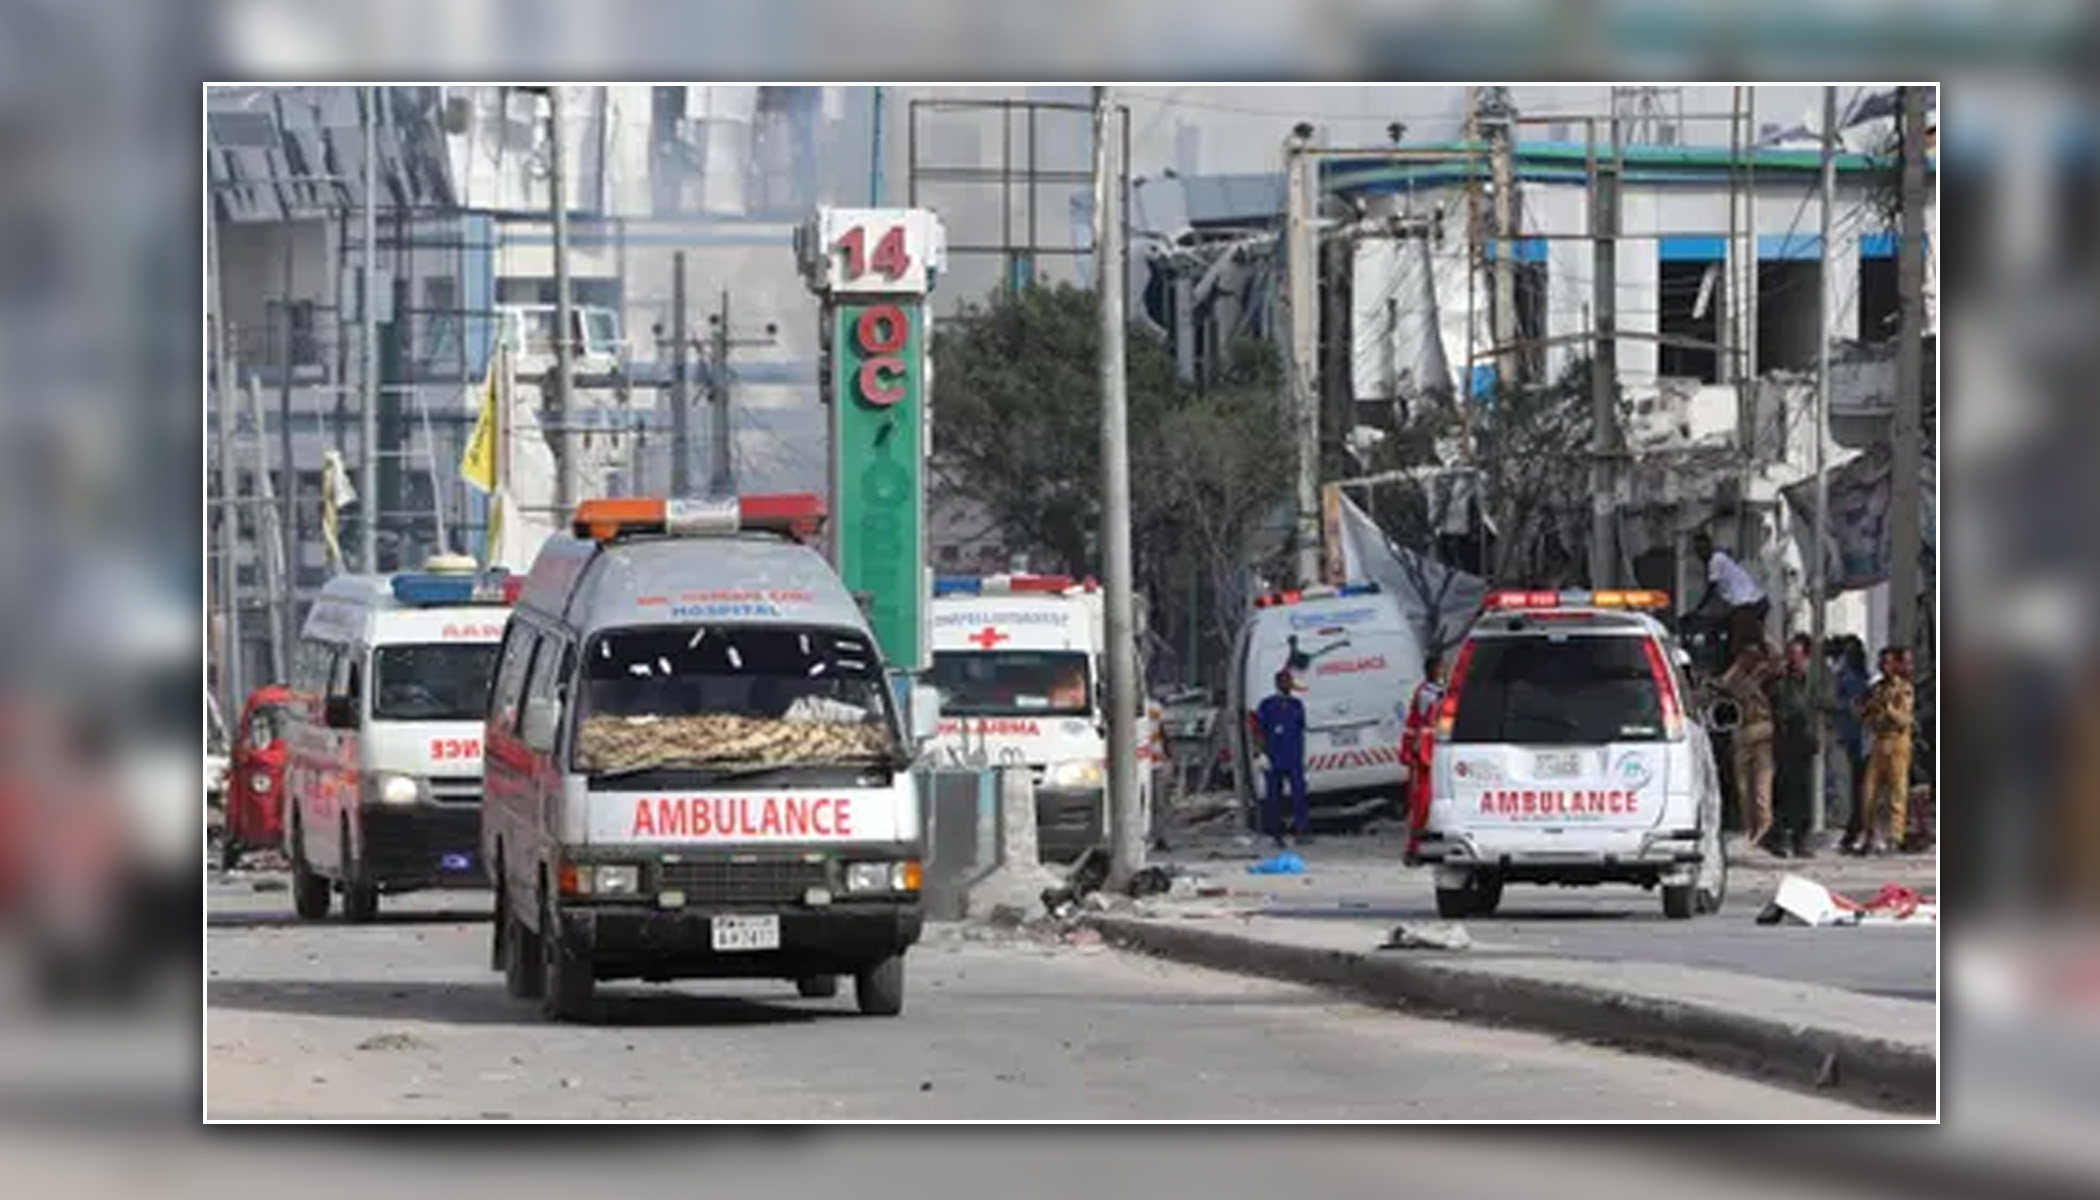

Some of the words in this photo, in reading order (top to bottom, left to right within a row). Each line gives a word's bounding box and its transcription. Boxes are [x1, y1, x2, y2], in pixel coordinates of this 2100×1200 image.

[834, 224, 910, 283] 14
[672, 604, 782, 617] HOSPITAL
[632, 798, 853, 836] AMBULANCE
[1480, 791, 1639, 814] AMBULANCE
